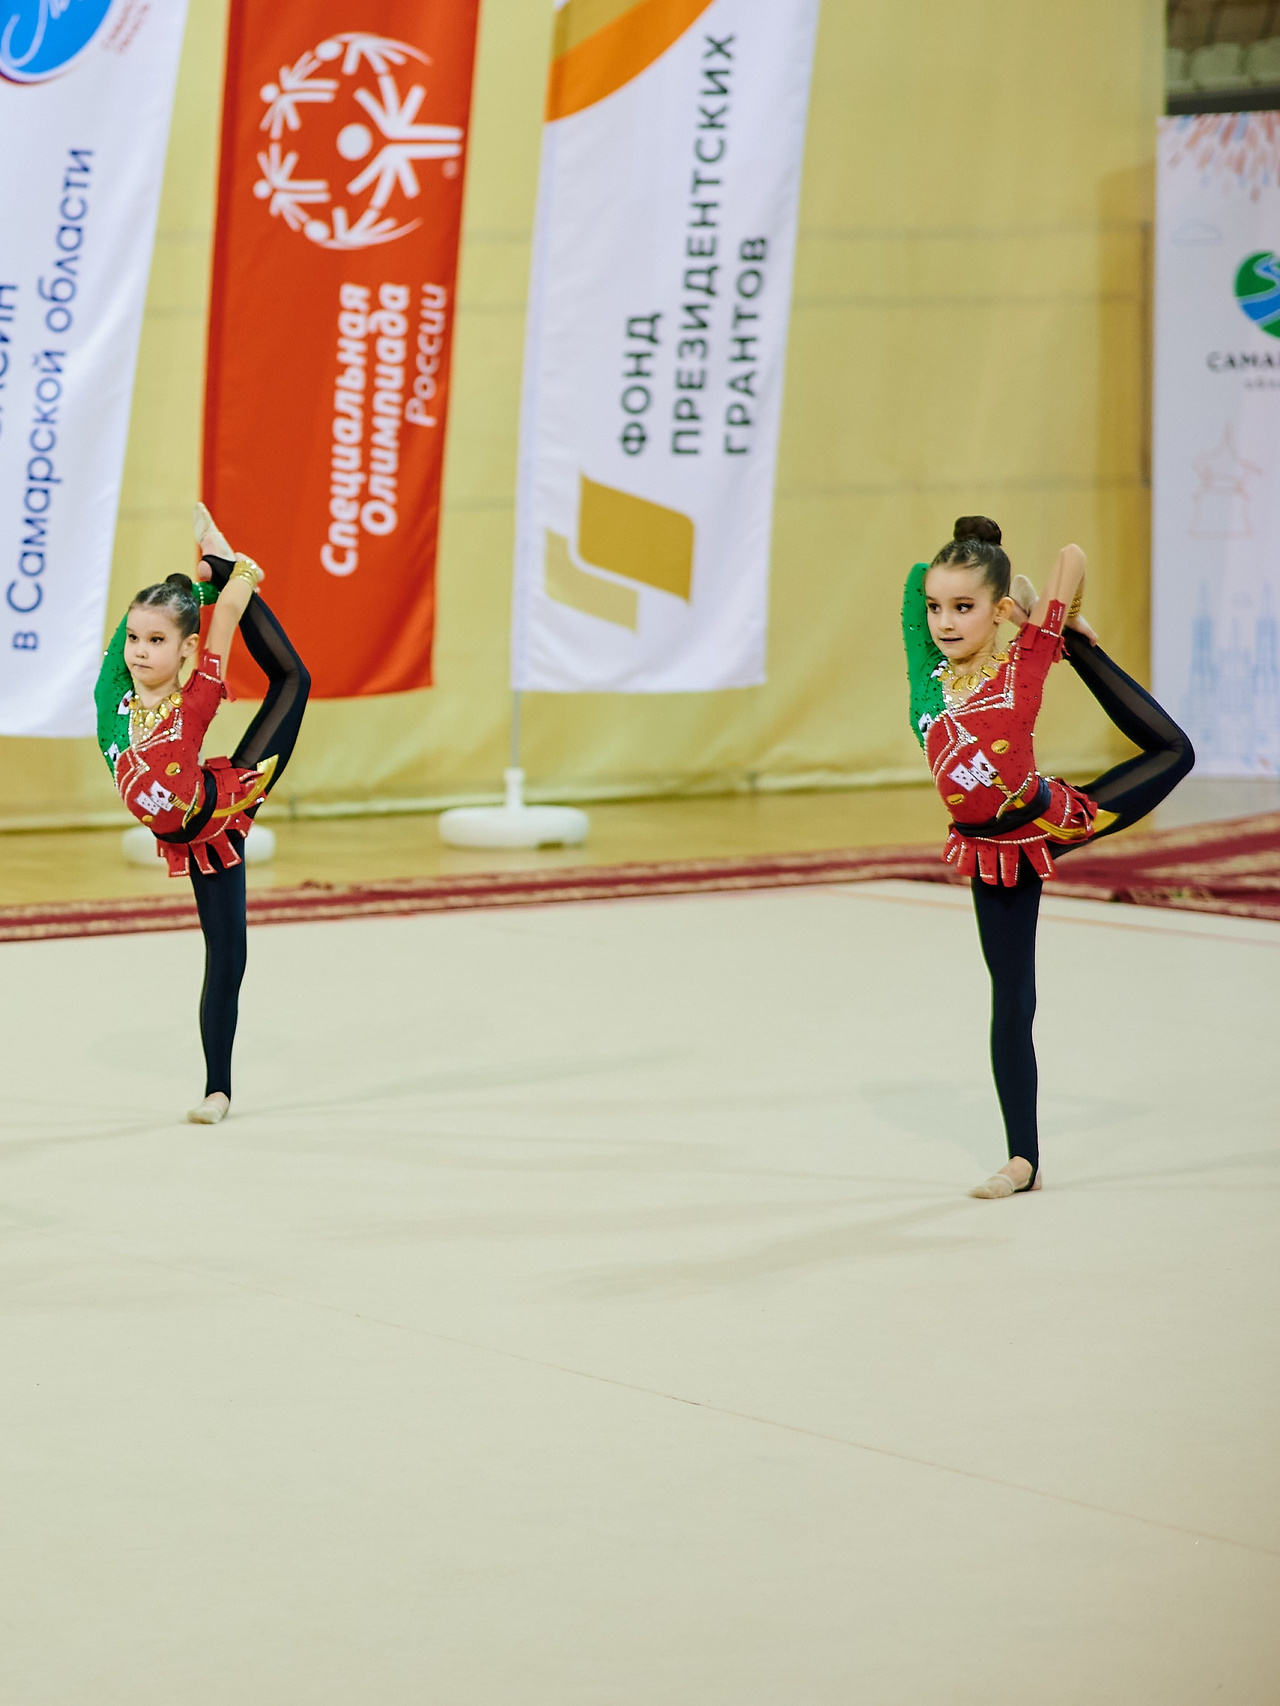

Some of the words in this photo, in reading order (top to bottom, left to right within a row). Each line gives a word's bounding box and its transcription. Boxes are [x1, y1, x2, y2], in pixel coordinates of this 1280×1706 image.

[37, 148, 94, 333] области
[671, 33, 736, 455] ПРЕЗИДЕНТСКИХ
[320, 282, 371, 577] Специальная
[360, 282, 410, 536] Олимпиада
[404, 282, 447, 428] России
[620, 313, 662, 455] ФОНД
[725, 237, 767, 455] ГРАНТОВ
[1206, 351, 1280, 371] САМА
[6, 350, 66, 613] Самарской
[12, 631, 39, 650] в
